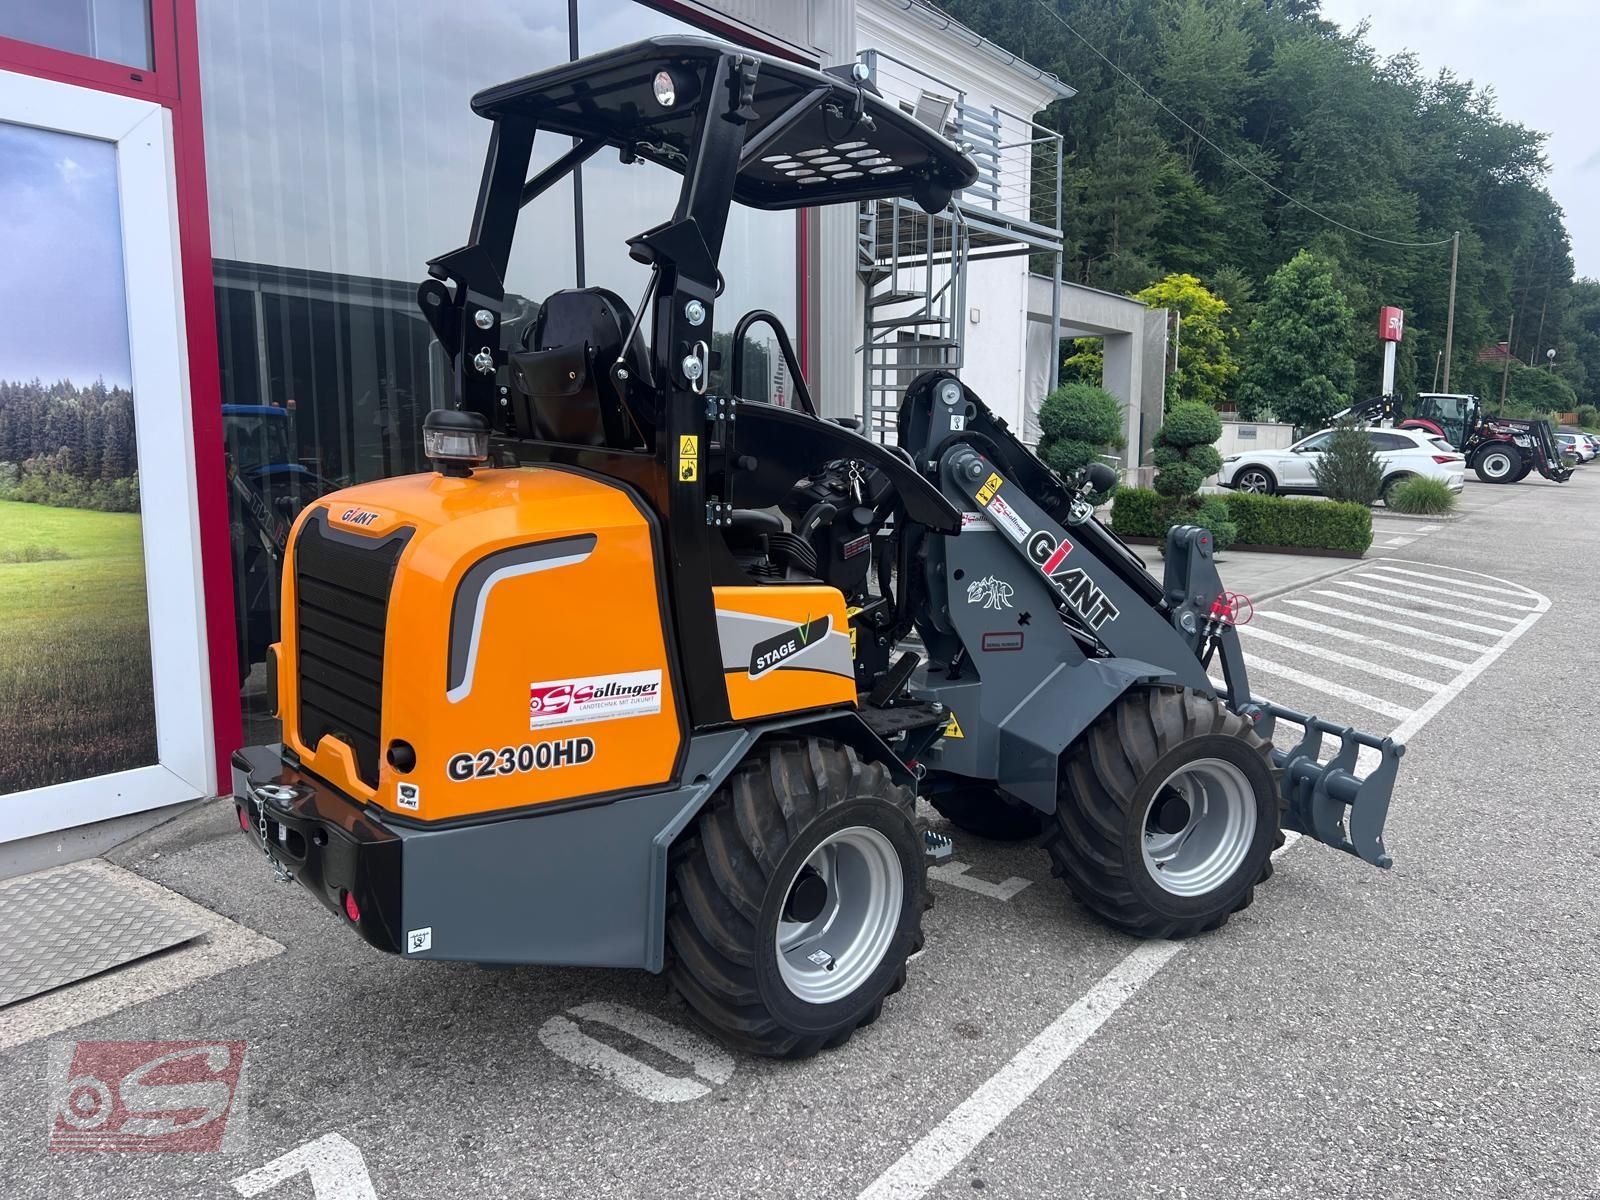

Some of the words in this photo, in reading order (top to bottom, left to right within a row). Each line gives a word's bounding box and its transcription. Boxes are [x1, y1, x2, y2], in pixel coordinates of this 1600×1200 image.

[756, 640, 797, 669] STAGE
[573, 682, 659, 704] Söllinger
[579, 701, 618, 711] LANDTECHNIK
[630, 696, 655, 705] ZUKUNFT
[447, 736, 596, 782] G2300HD
